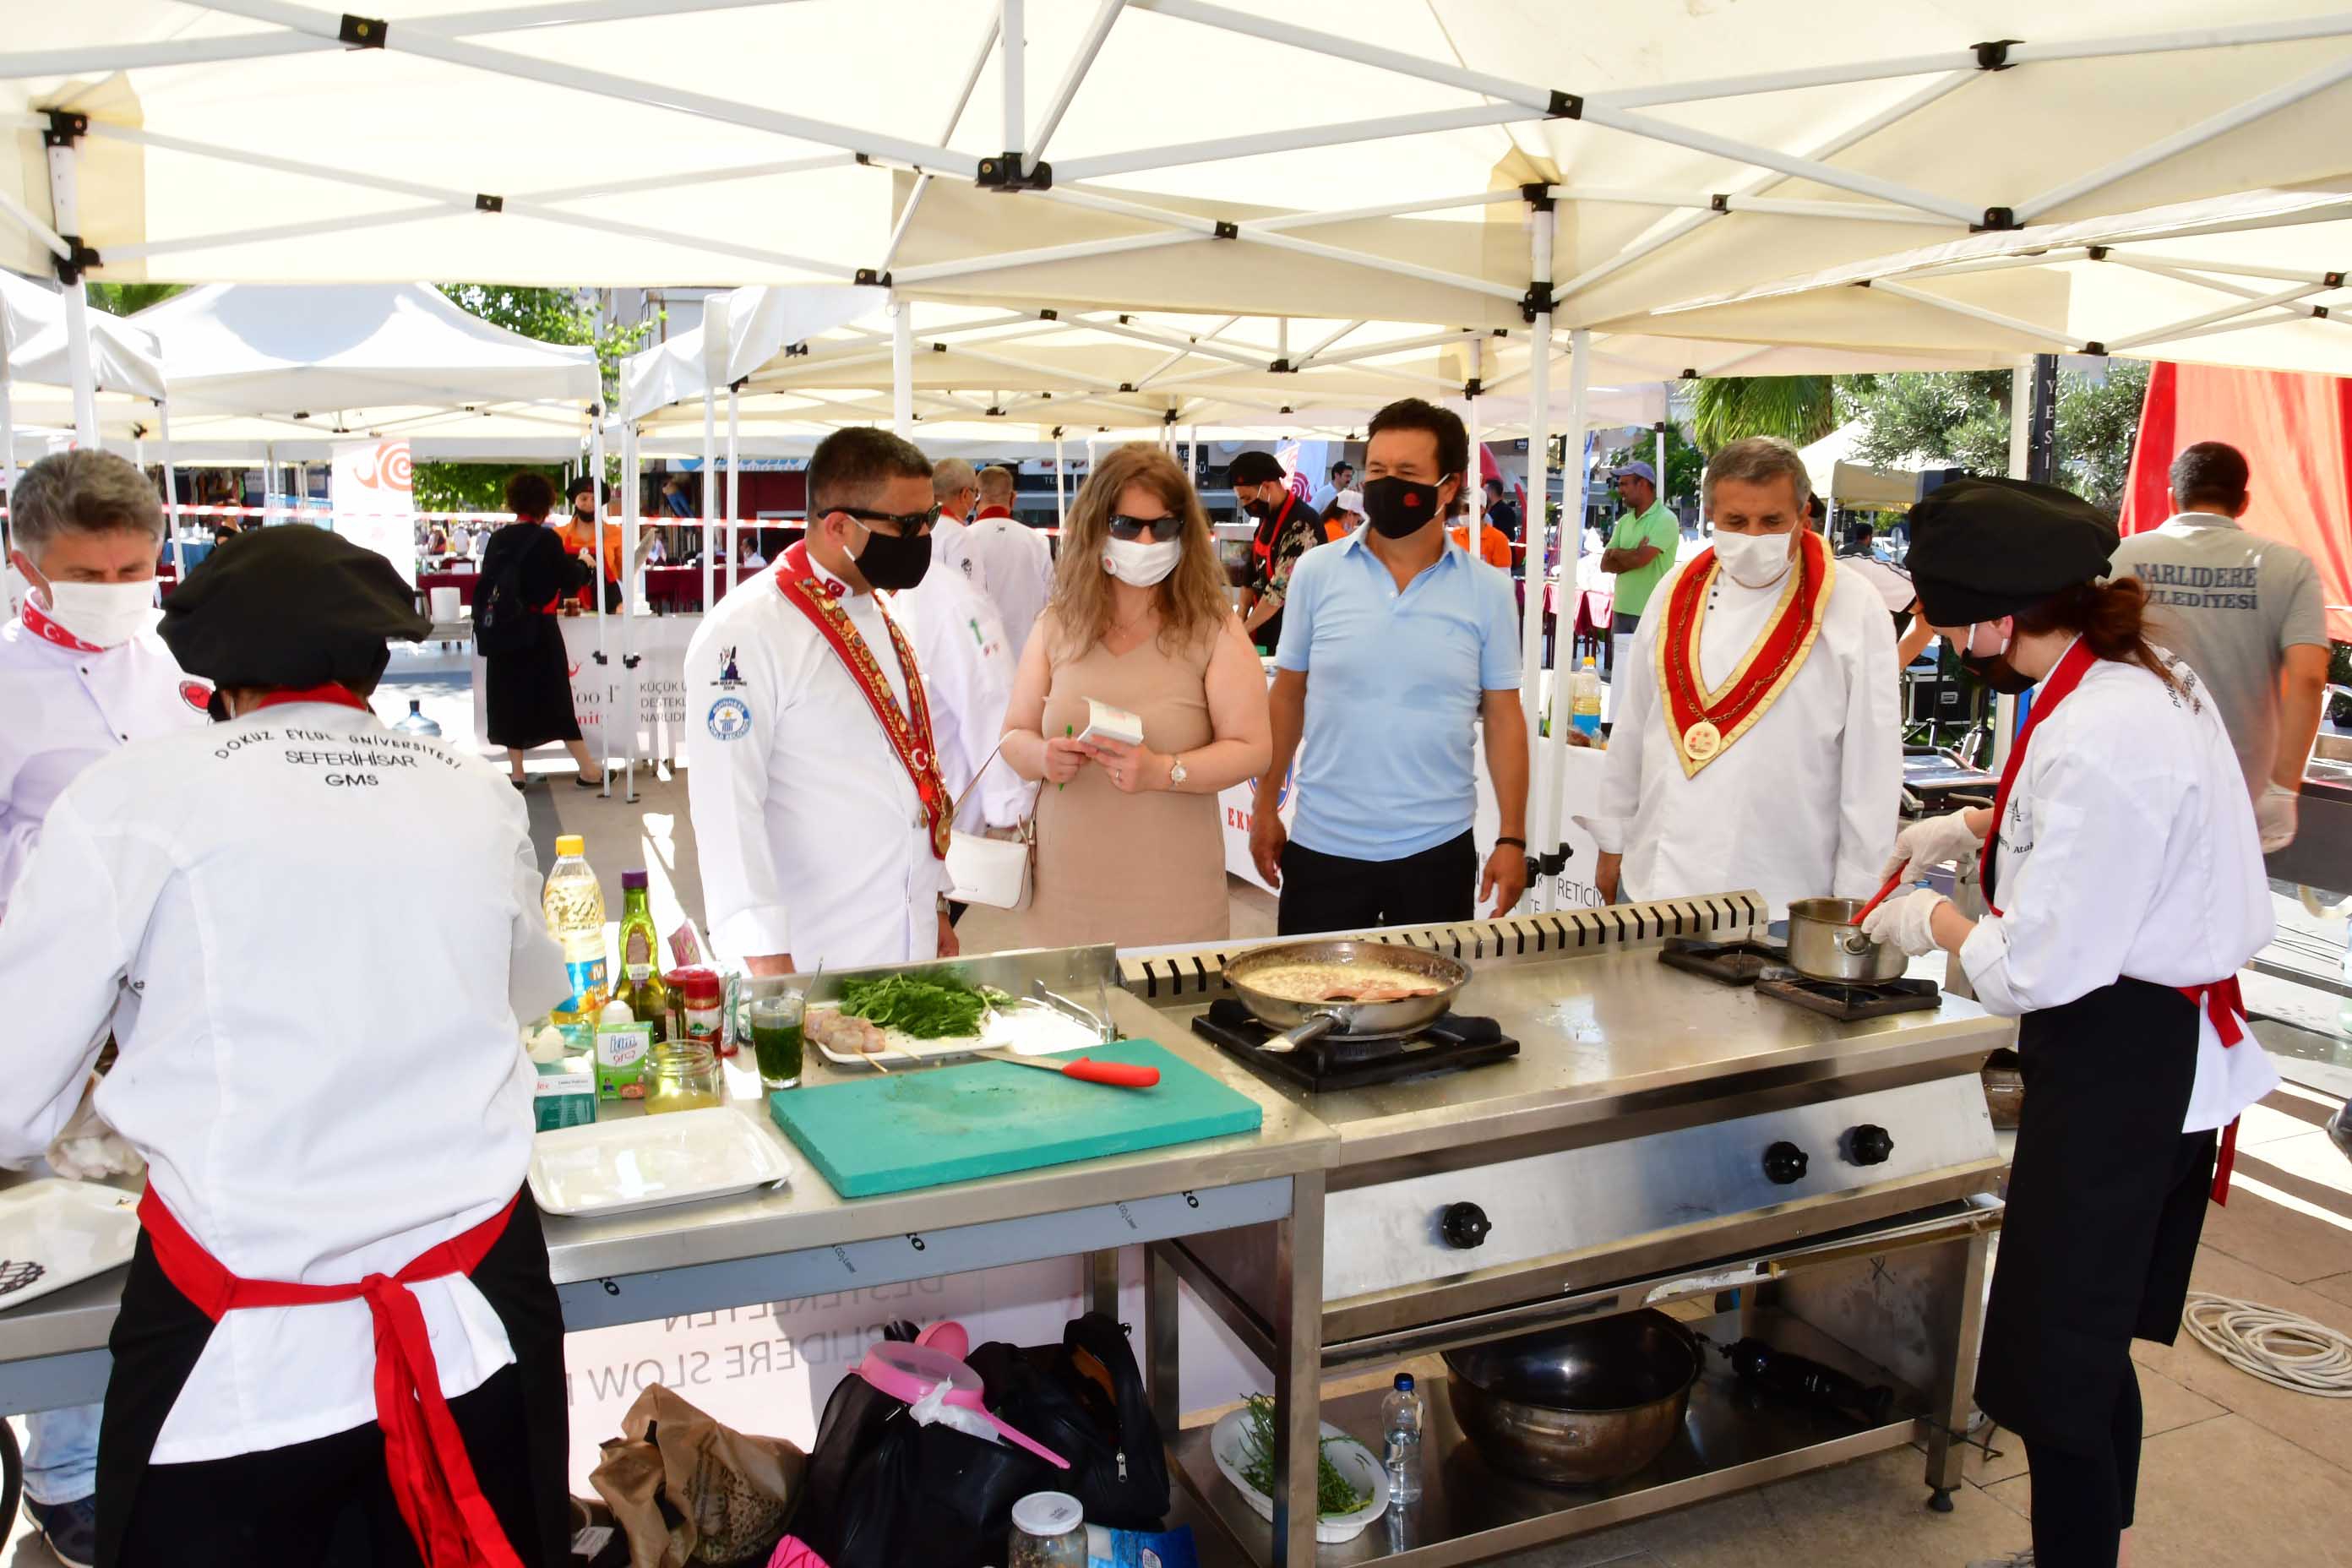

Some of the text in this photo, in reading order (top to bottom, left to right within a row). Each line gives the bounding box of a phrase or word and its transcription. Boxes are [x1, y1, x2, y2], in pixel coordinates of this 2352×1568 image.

[640, 696, 686, 708] DESTEKL
[640, 712, 685, 723] NARLID
[215, 731, 275, 760] DOKUZ
[325, 774, 378, 787] GMS
